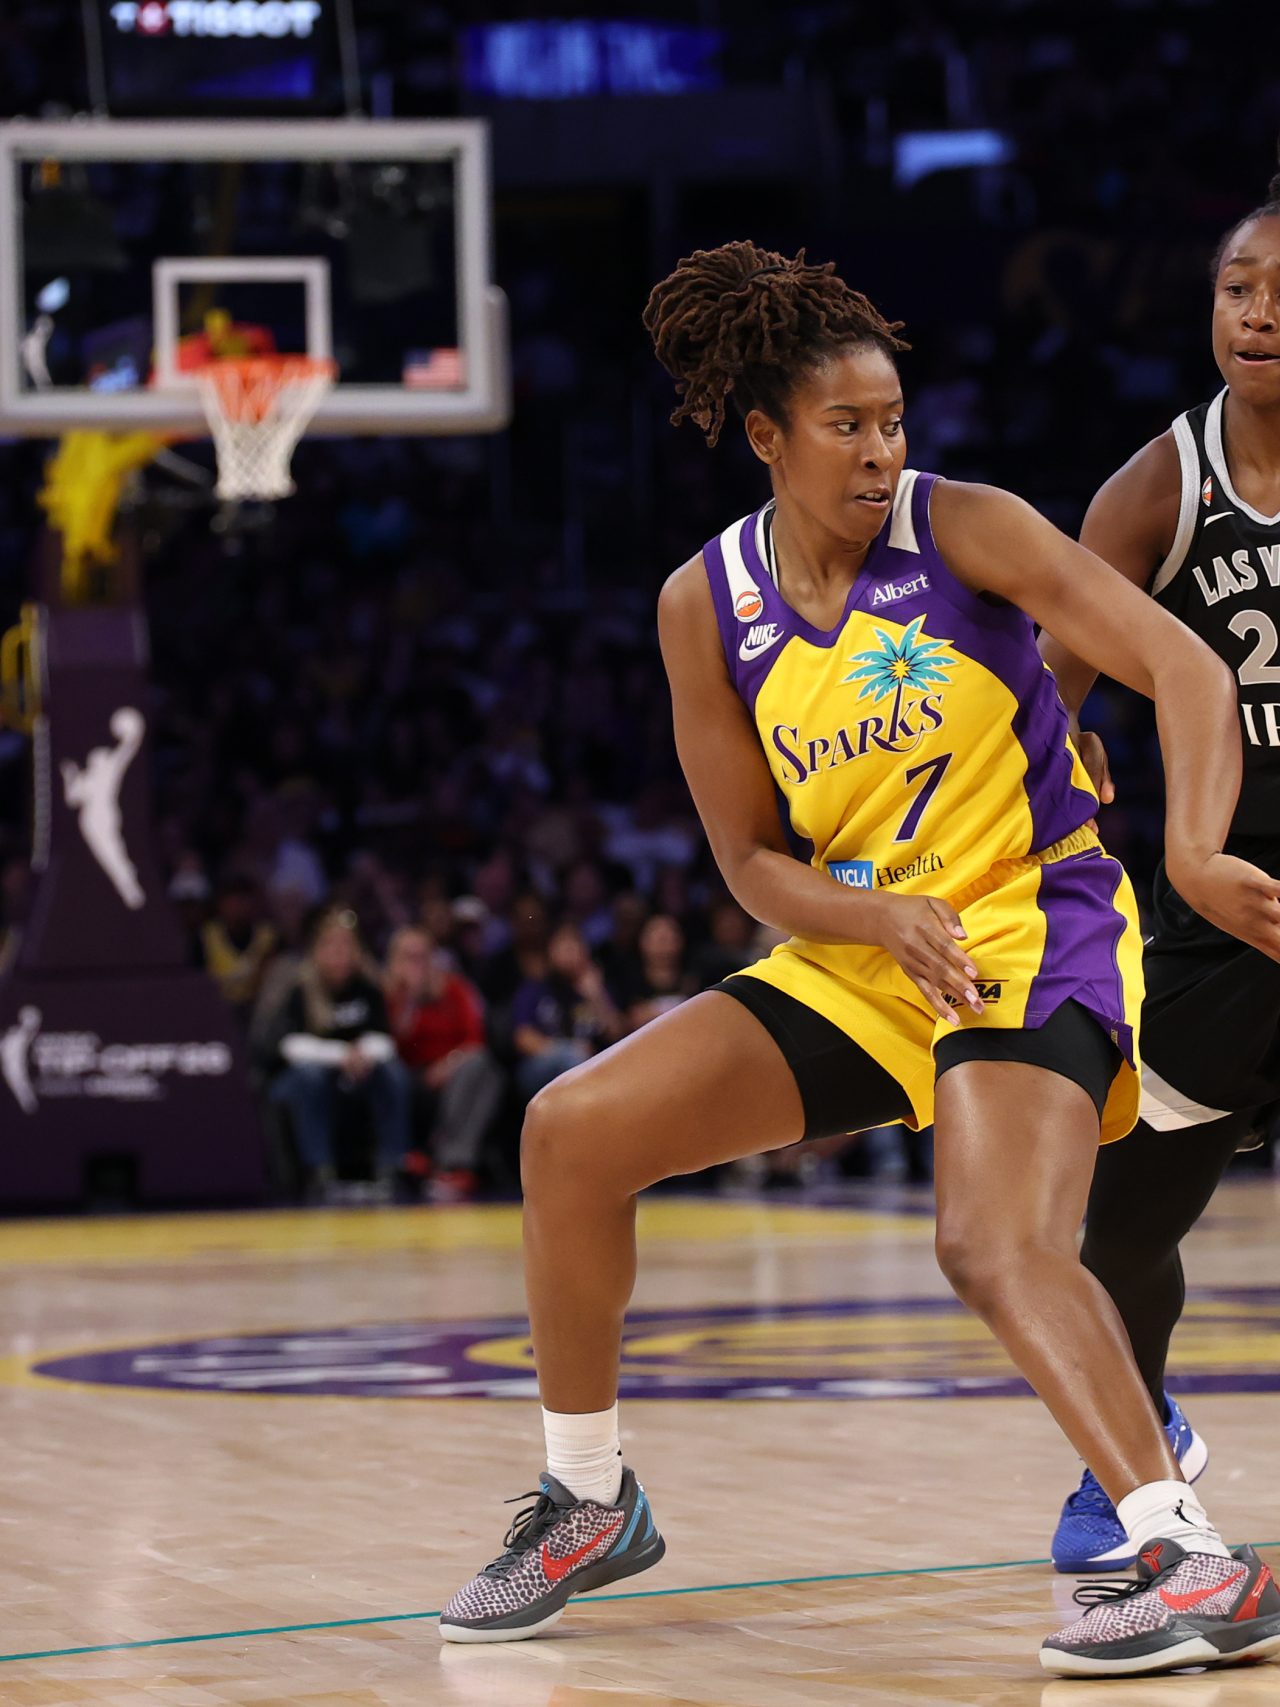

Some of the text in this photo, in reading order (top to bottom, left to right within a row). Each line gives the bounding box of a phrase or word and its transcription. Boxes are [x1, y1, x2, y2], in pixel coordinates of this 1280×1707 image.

[871, 573, 929, 606] Albert
[1192, 549, 1258, 606] LAS
[746, 623, 778, 646] NIKE
[892, 751, 953, 844] 7
[835, 853, 944, 888] UCLA Health
